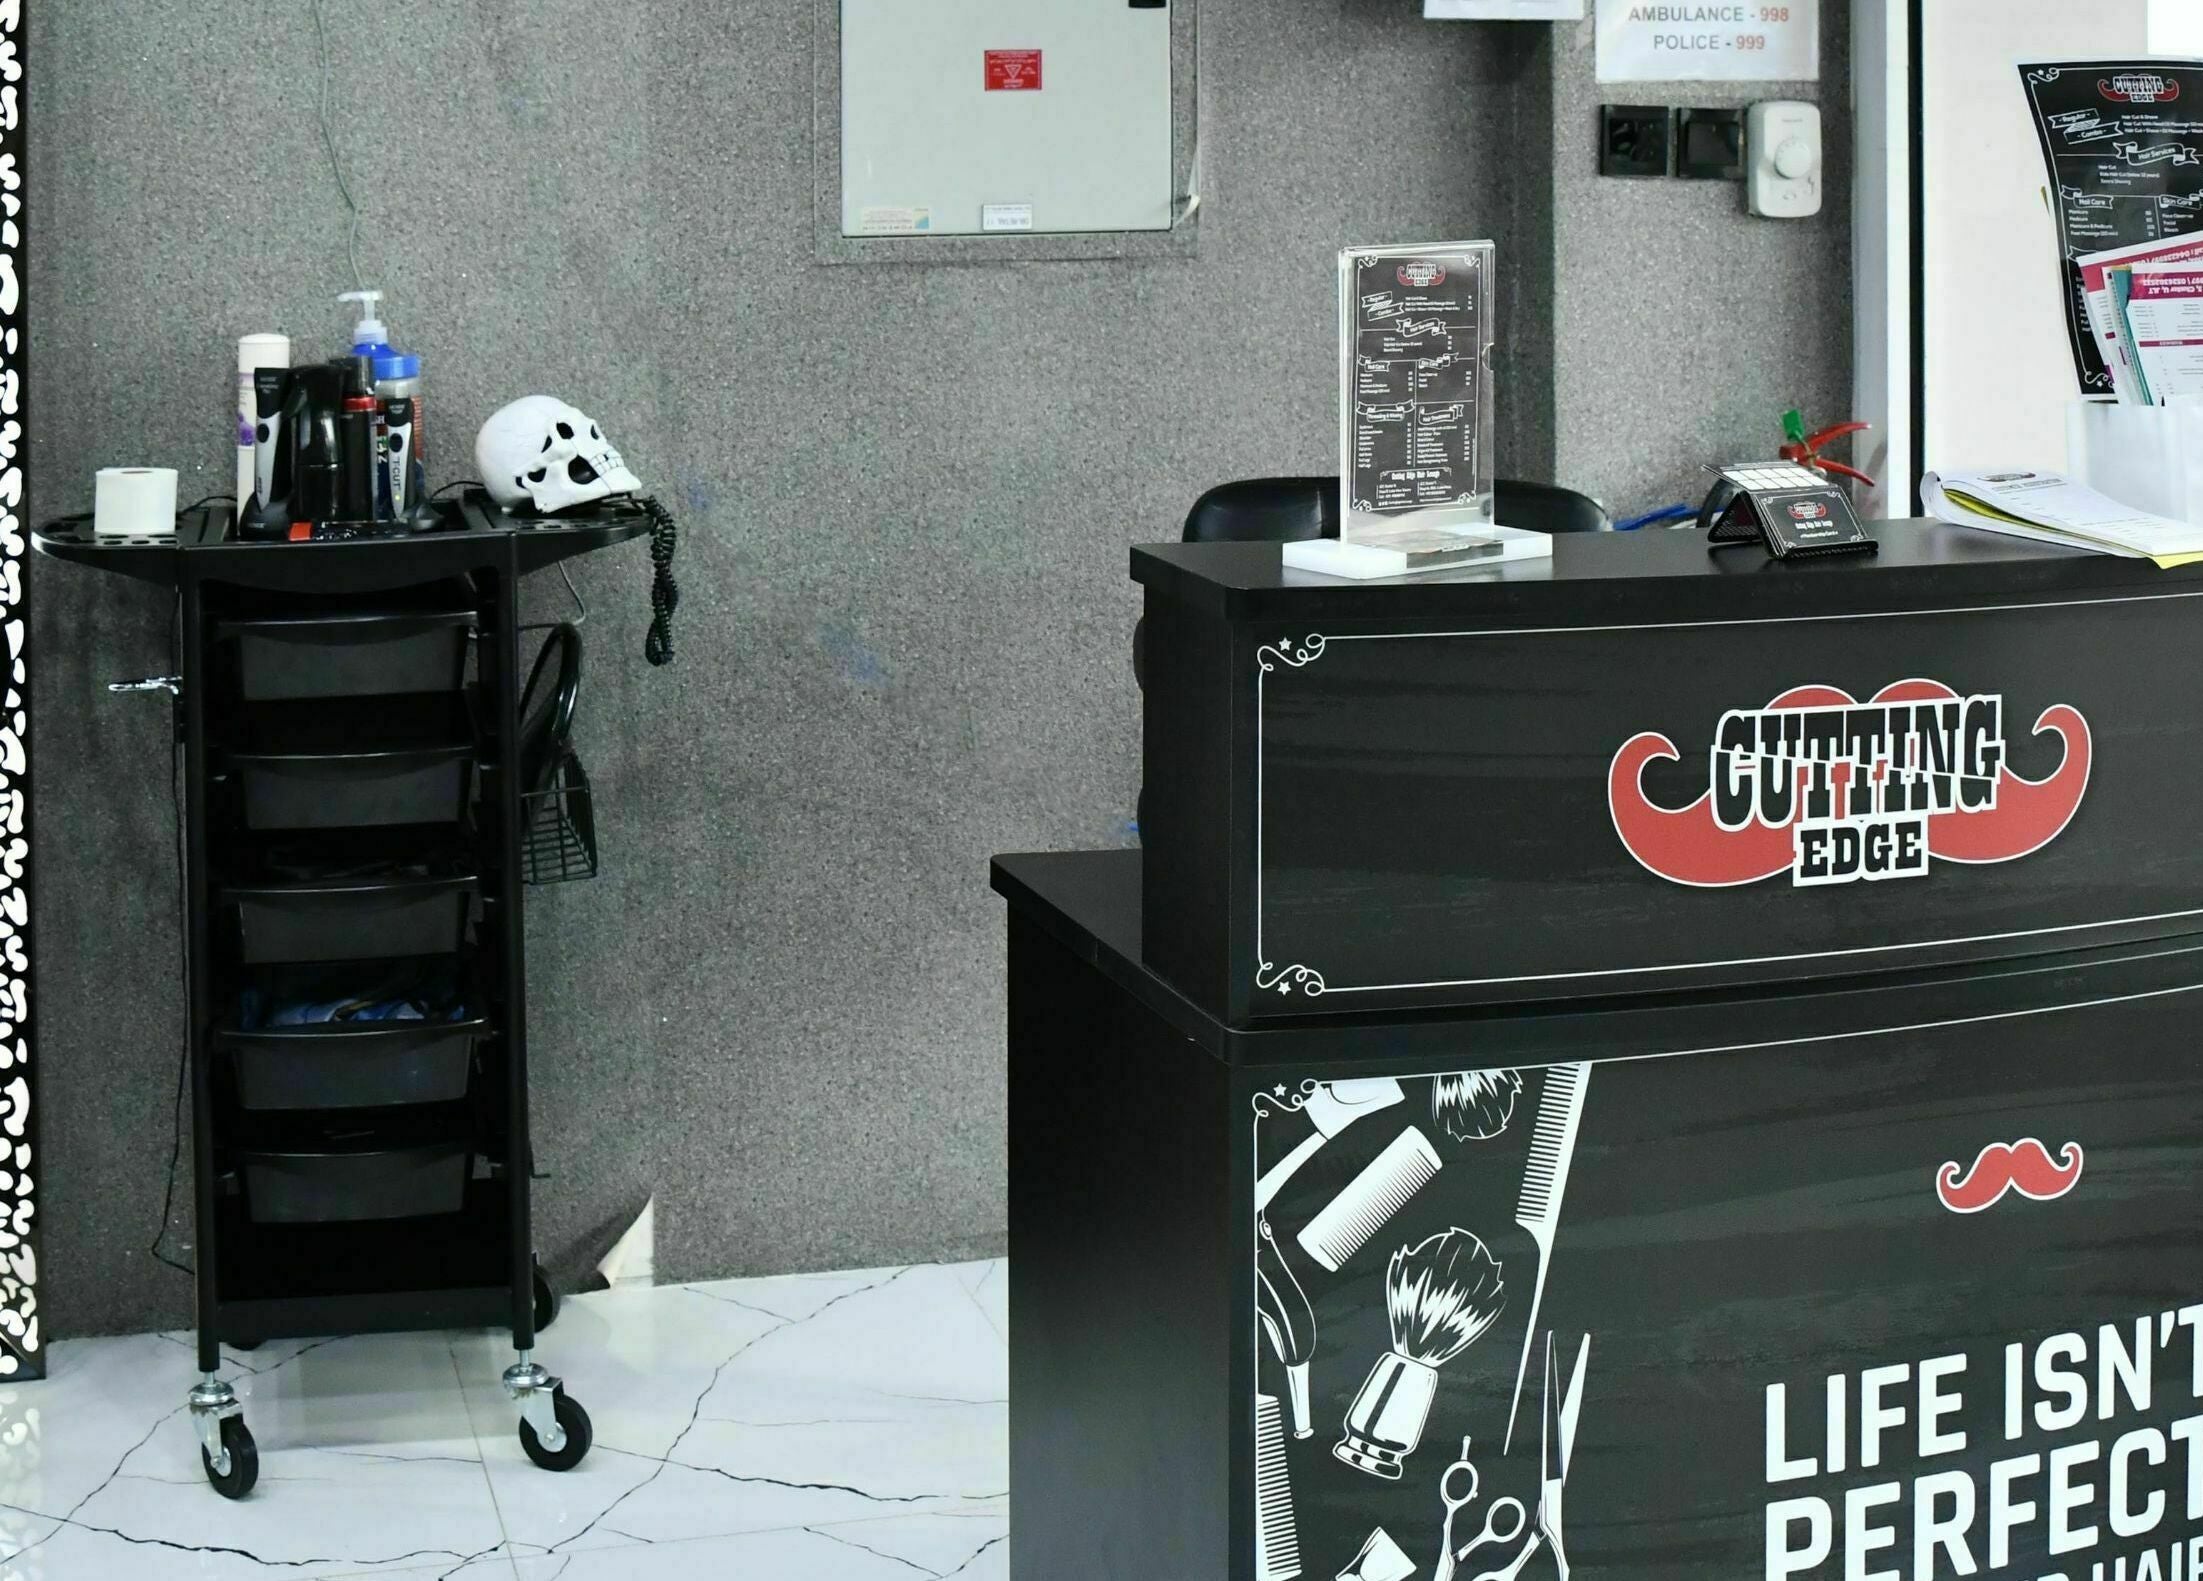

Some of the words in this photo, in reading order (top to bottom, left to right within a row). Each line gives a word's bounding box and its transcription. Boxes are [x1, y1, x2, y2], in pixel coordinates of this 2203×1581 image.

[1629, 7, 1744, 22] AMBULANCE
[1760, 7, 1789, 22] 998
[1653, 35, 1720, 50] POLICE
[1736, 35, 1765, 50] 999
[2113, 76, 2164, 94] CUTTING
[1711, 695, 2005, 832] CUTTING
[1796, 818, 1926, 883] EDGE
[1766, 1353, 1967, 1483] LIFE
[2005, 1303, 2203, 1440] ISN'T
[1766, 1414, 2203, 1581] PERFECT
